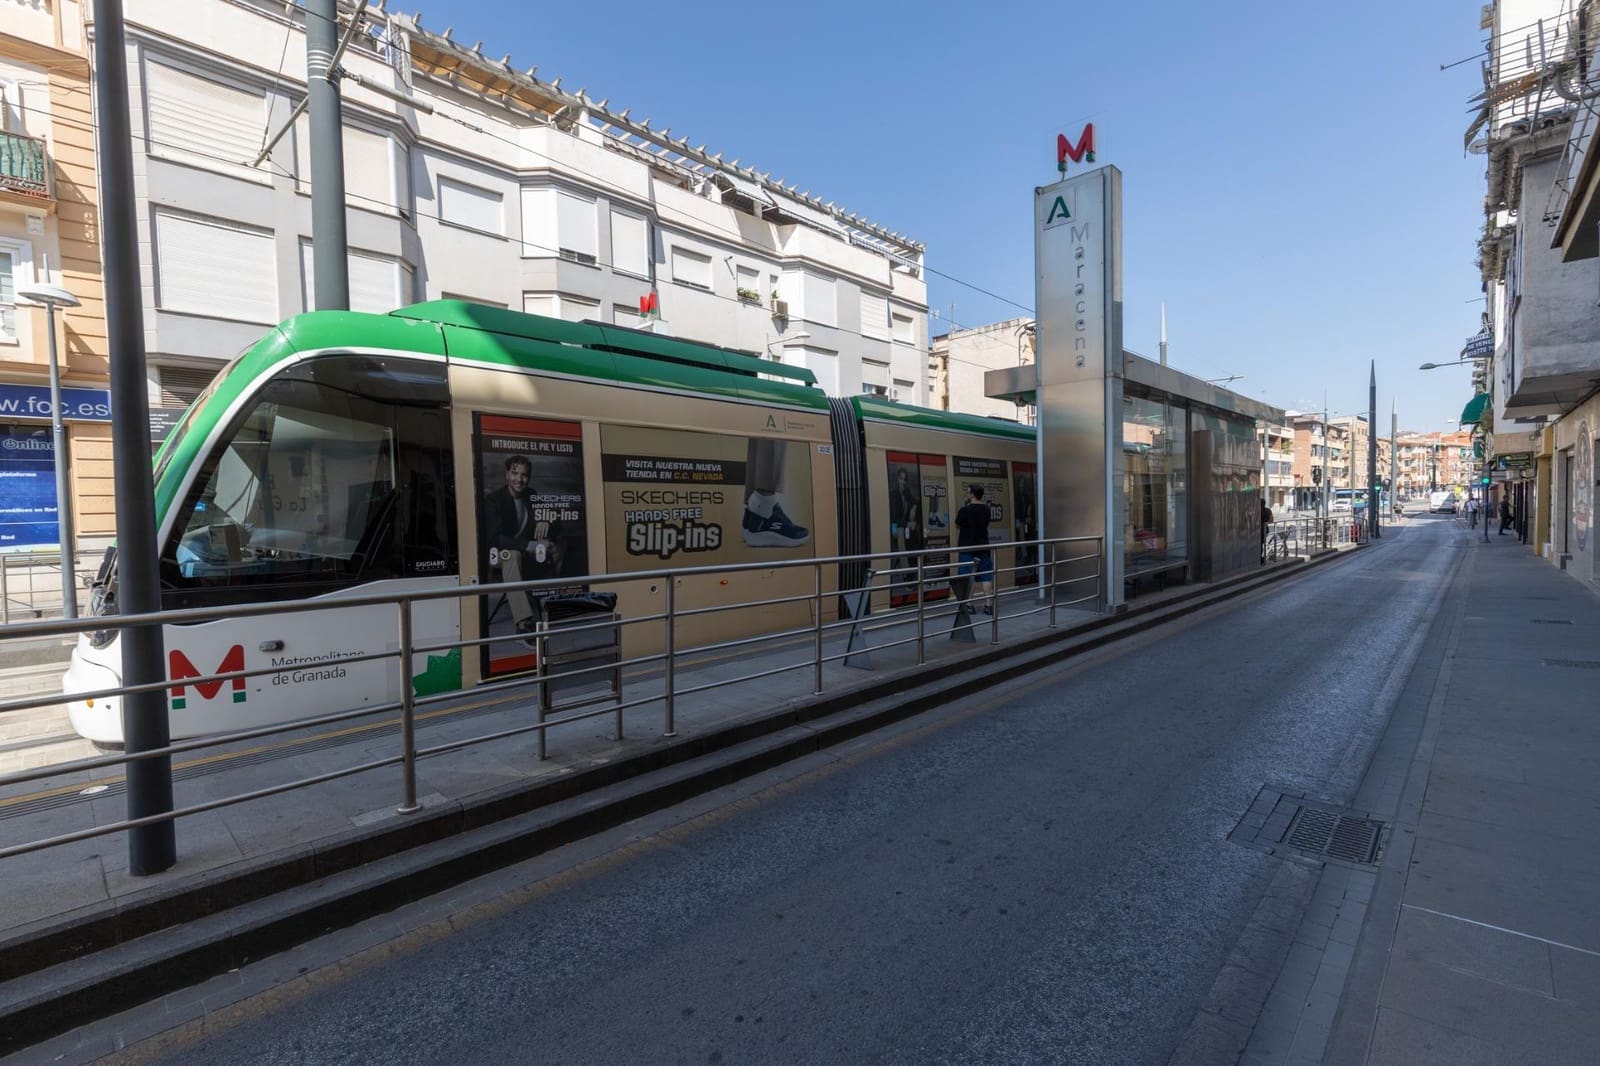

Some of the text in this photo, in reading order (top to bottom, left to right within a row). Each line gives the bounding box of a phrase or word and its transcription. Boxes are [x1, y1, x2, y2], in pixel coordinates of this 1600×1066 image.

[1057, 122, 1096, 171] M
[1070, 222, 1089, 368] Maracena
[491, 439, 573, 453] INTRODUCE EL PIE Y LISTO
[625, 459, 722, 472] VISITA NUESTRA NUEVA
[625, 470, 724, 481] TIENDA EN C.C. NEVADA
[529, 494, 582, 502] SKECHERS
[621, 490, 724, 505] SKECHERS
[534, 508, 579, 523] Slip-ins
[625, 508, 703, 523] HANDS FREE
[629, 521, 720, 556] Slip-ins
[169, 644, 247, 710] M
[272, 666, 347, 686] de Granada
